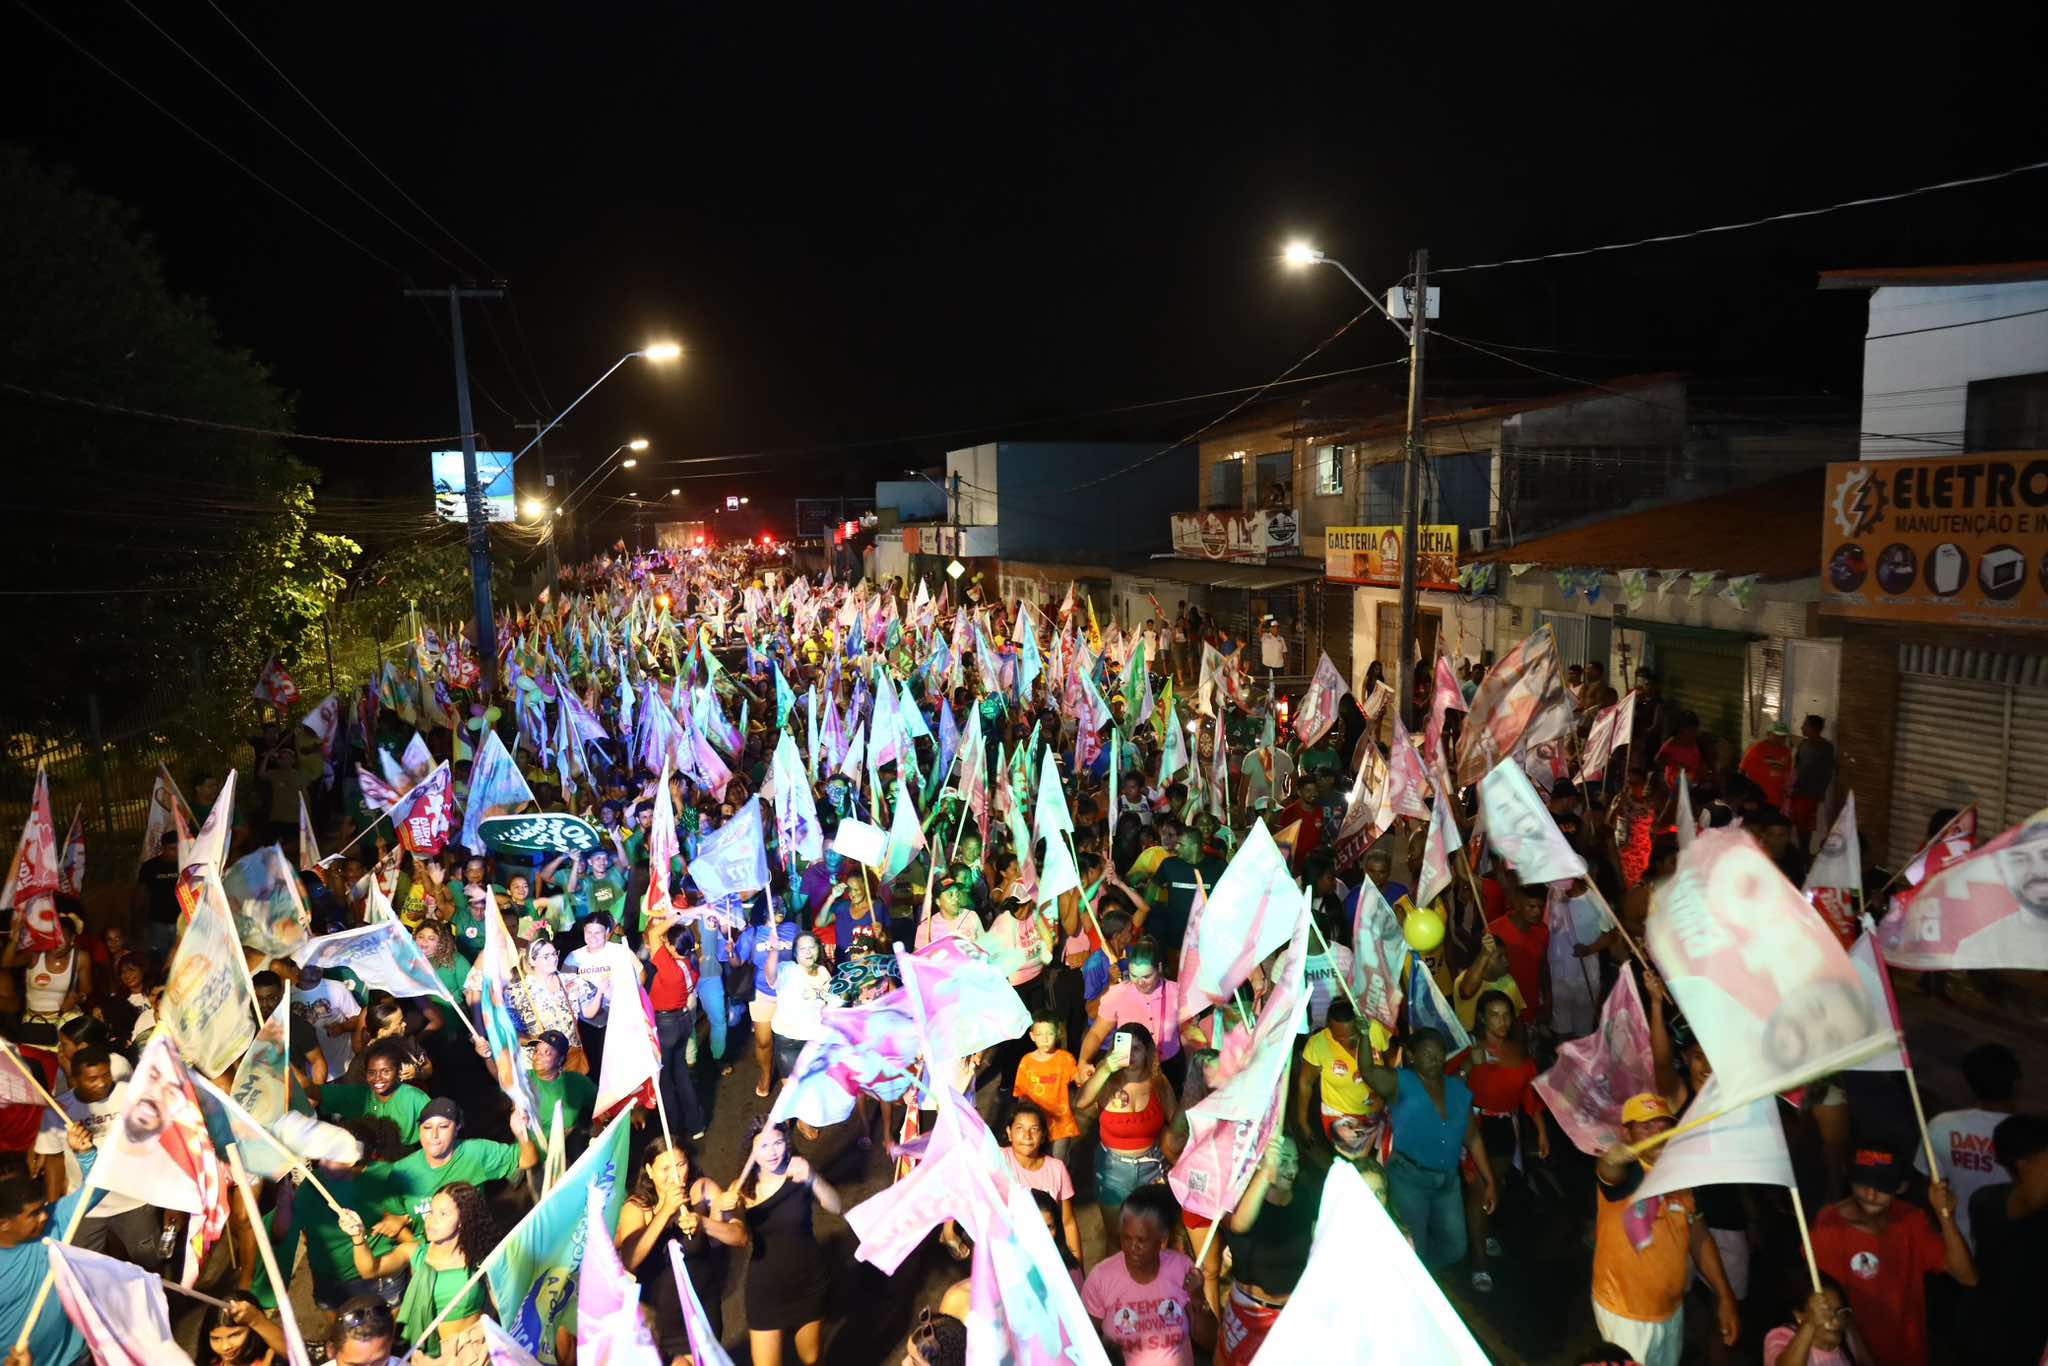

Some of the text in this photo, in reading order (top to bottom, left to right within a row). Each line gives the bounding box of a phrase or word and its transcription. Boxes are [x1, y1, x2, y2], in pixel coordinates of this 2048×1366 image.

[1896, 512, 2013, 538] MANUTENÇÃO
[2018, 513, 2030, 533] E
[1328, 532, 1377, 551] GALETERIA
[1951, 1150, 1993, 1173] REIS
